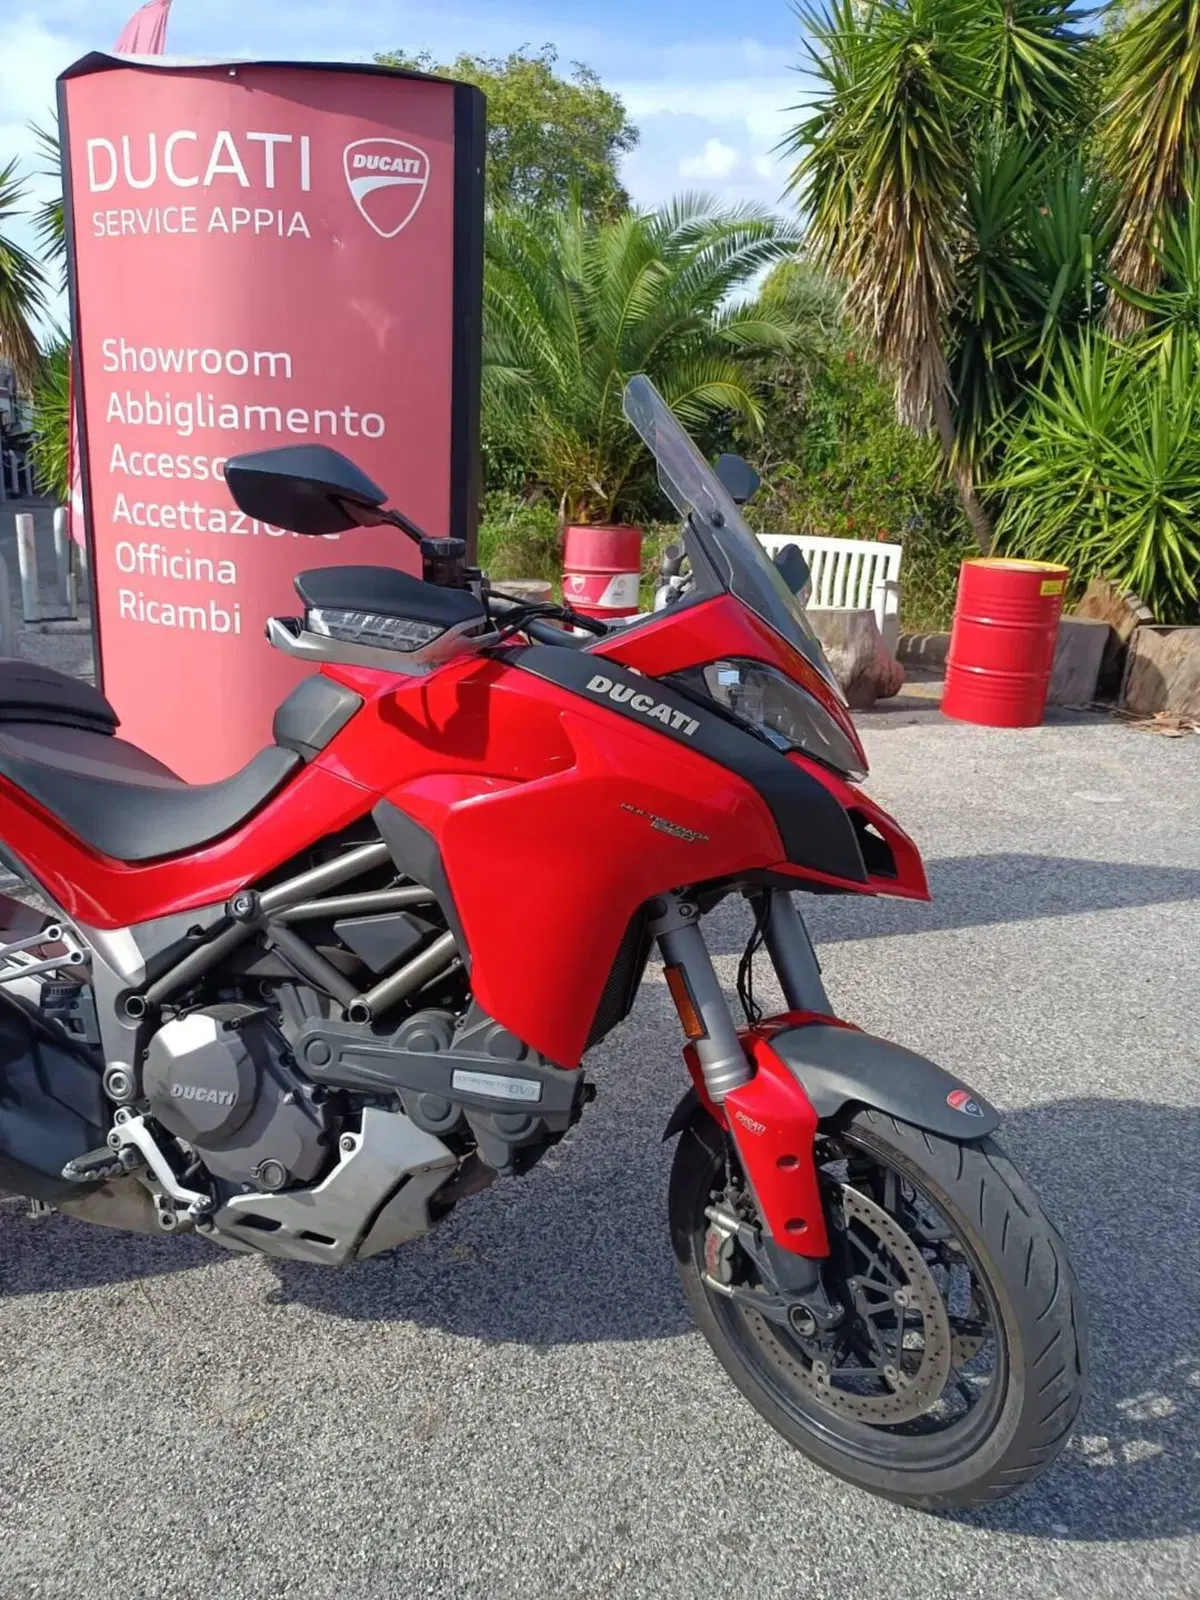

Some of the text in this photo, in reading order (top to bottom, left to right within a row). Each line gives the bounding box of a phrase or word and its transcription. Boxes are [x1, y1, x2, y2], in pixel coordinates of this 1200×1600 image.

[87, 130, 311, 192] DUCATI
[353, 153, 421, 174] DUCATI
[92, 206, 311, 238] SERVICE APPIA
[101, 338, 293, 378] Showroom
[105, 390, 387, 438] Abbigliamento
[112, 492, 341, 540] Accettazi
[115, 541, 238, 585] Officina
[118, 588, 241, 634] Ricambi
[586, 675, 700, 736] DUCATI
[170, 1083, 236, 1106] DUCATI
